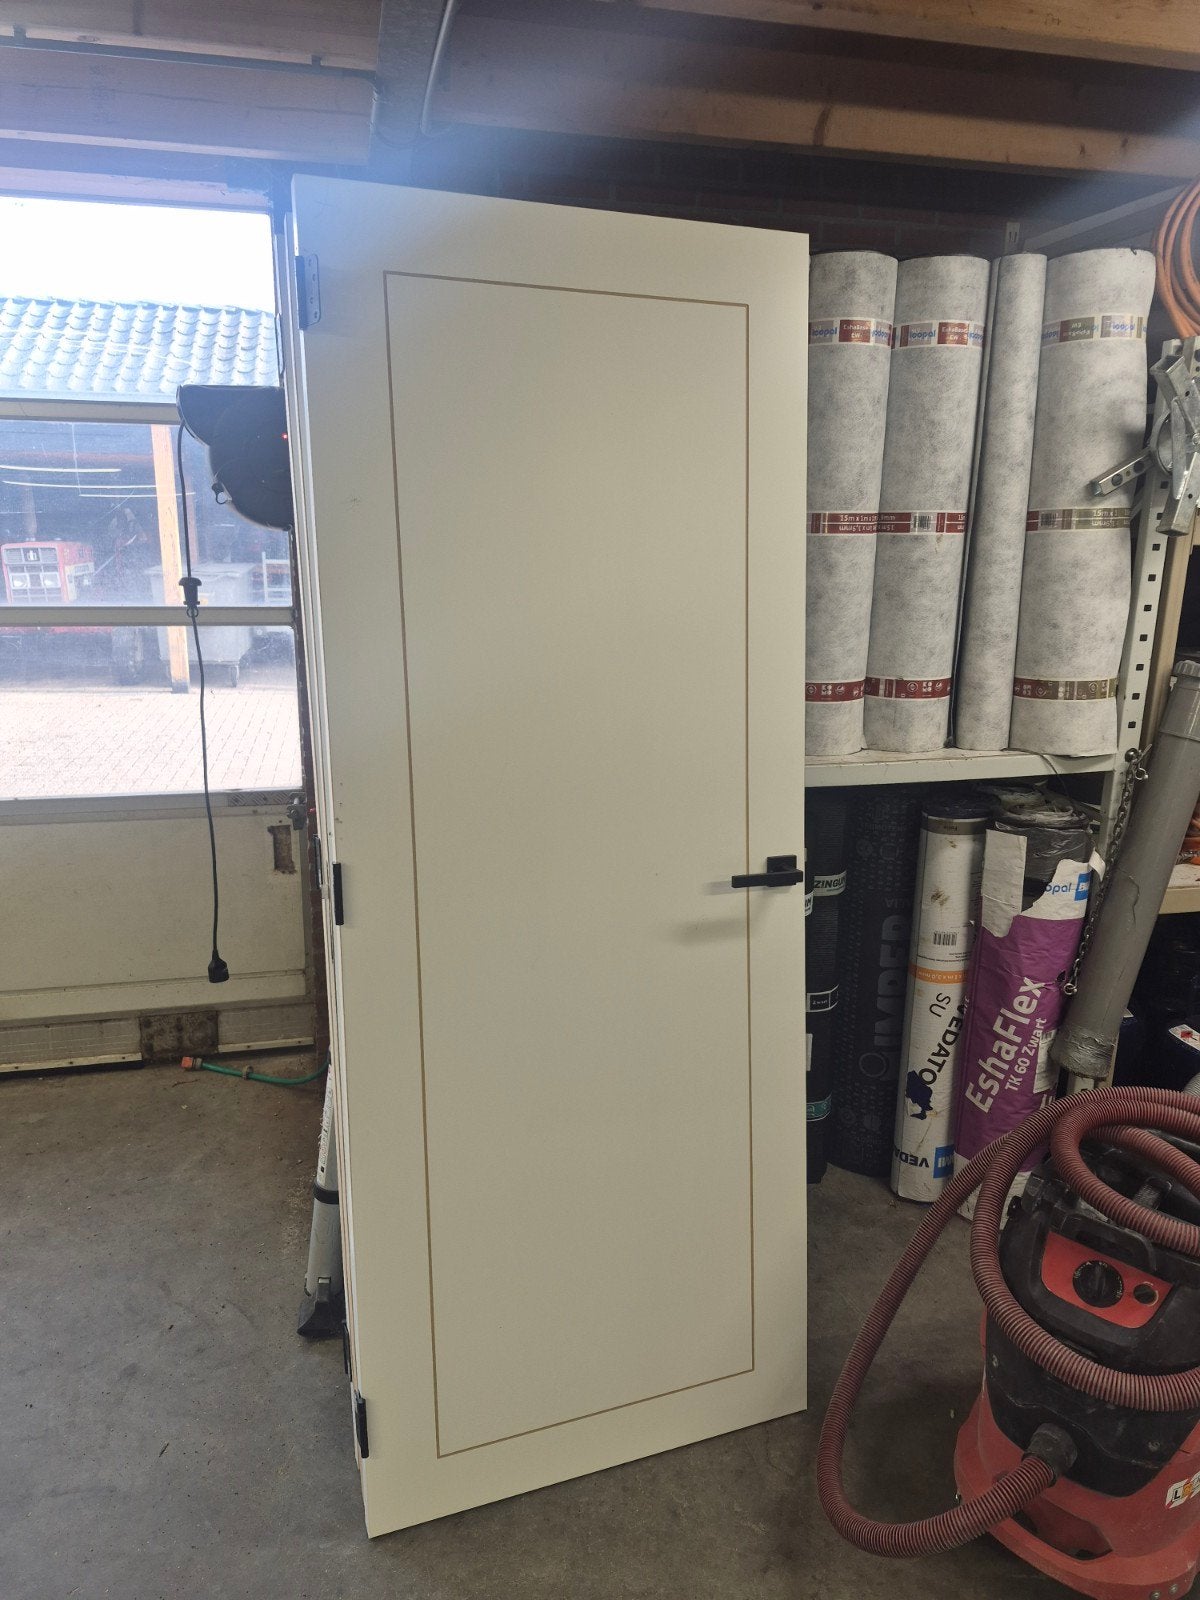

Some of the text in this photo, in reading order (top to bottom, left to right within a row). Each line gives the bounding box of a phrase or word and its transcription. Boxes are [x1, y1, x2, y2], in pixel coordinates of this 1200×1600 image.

[928, 991, 951, 1018] SU
[964, 976, 1046, 1114] EshaFlex
[1004, 1017, 1048, 1092] TK 60 Zwart
